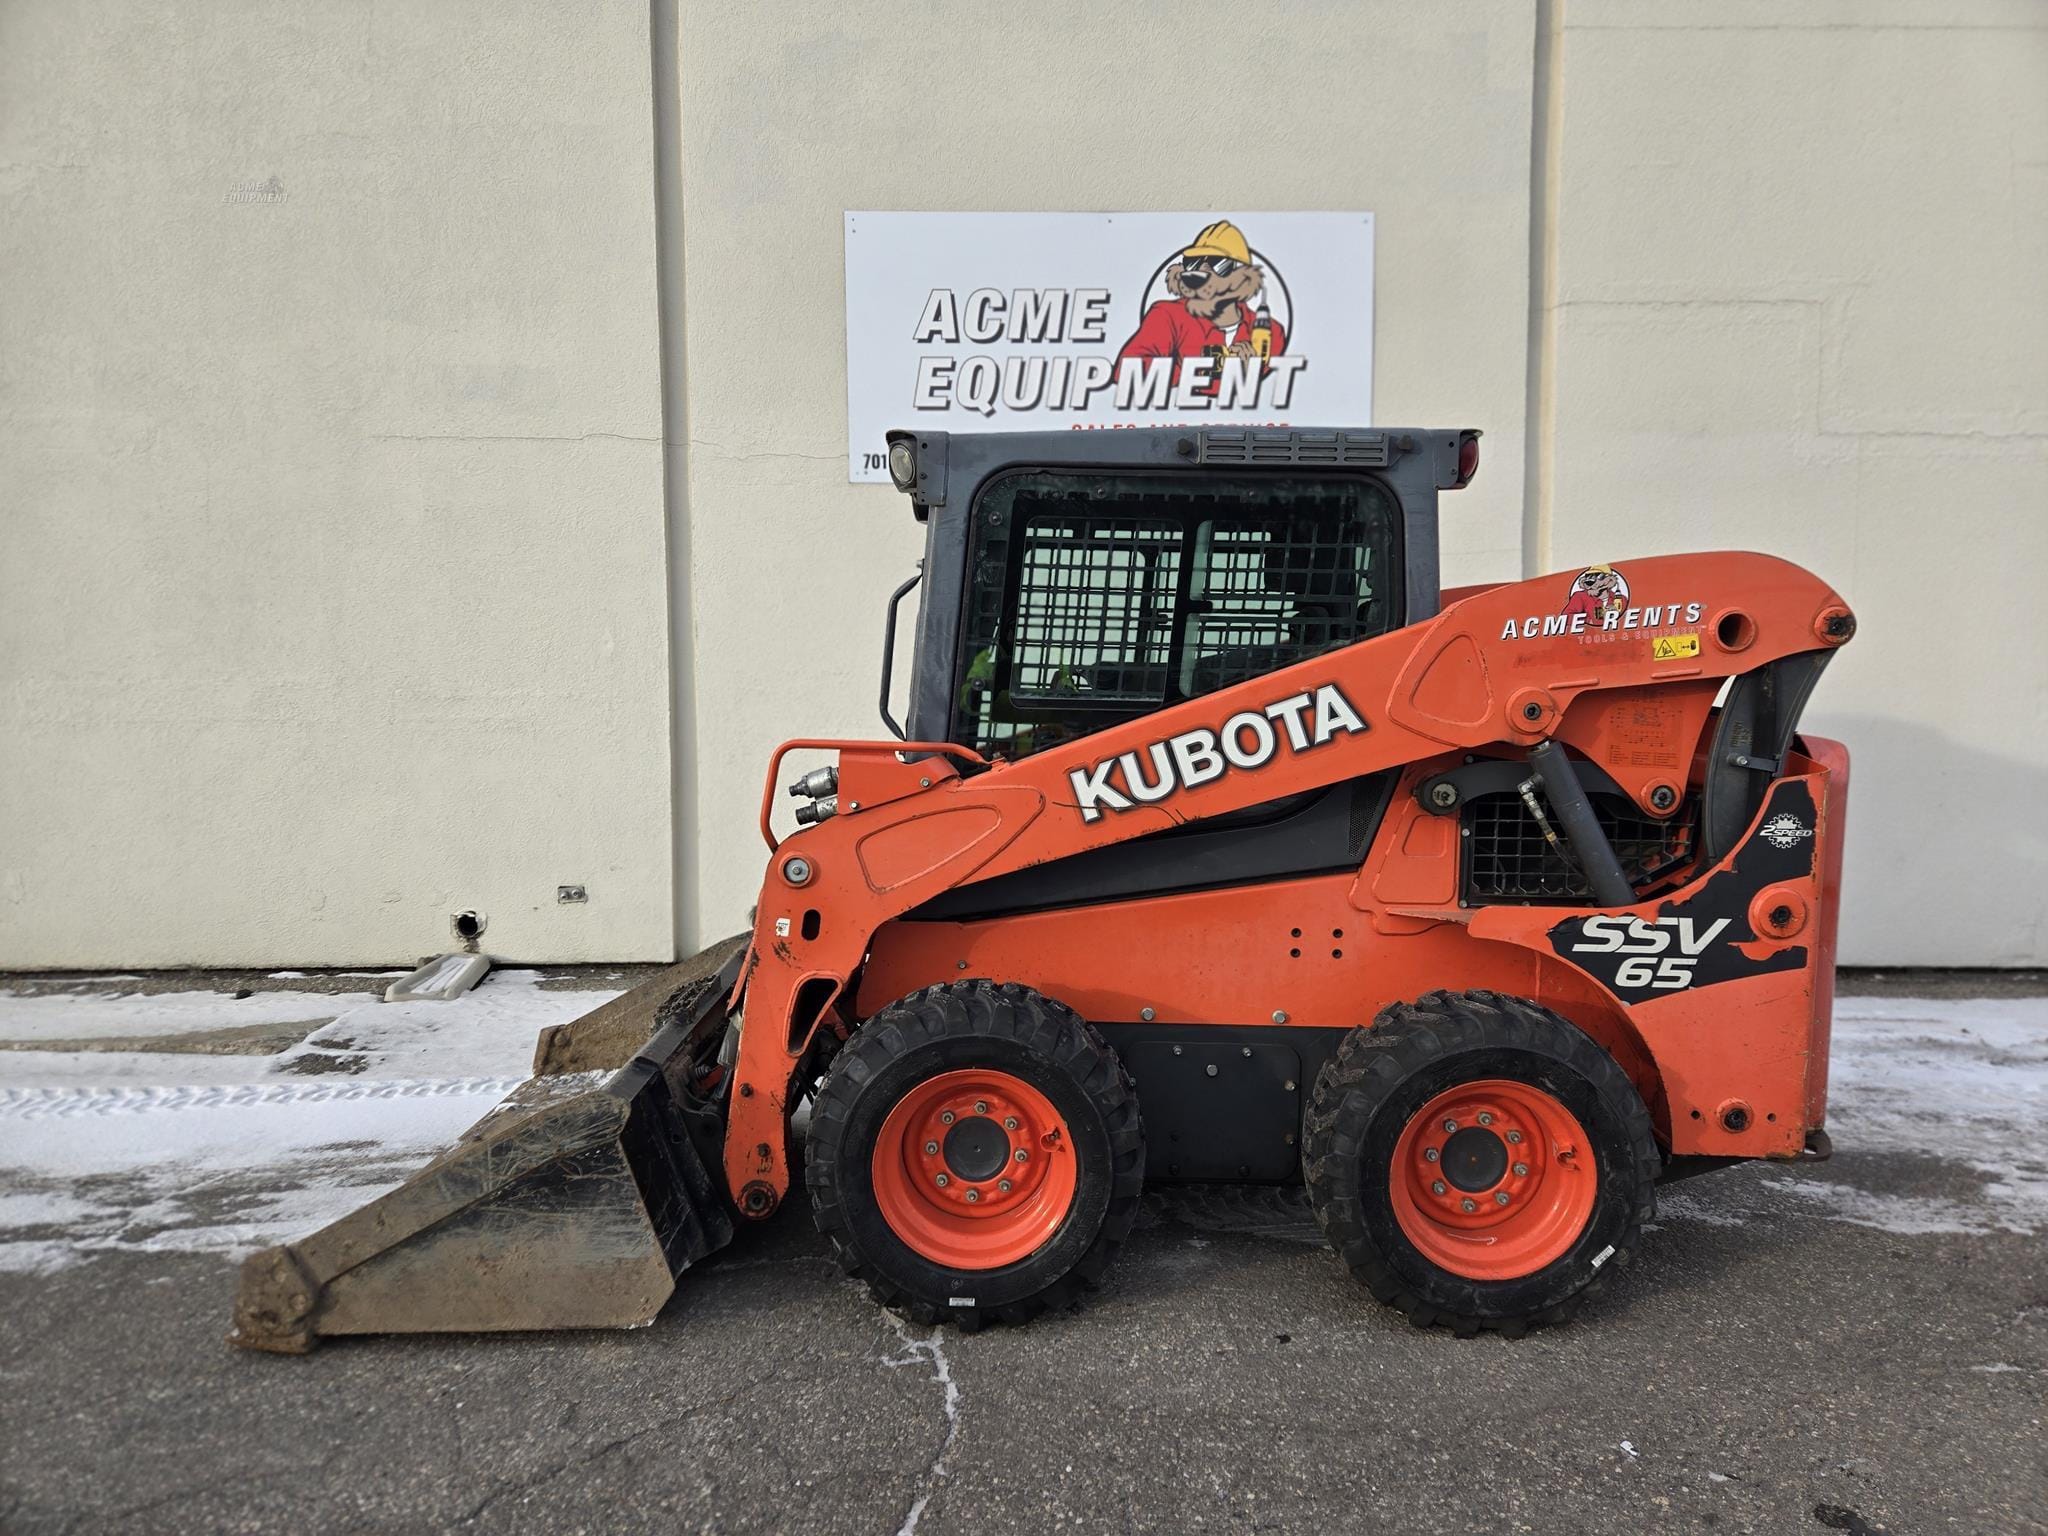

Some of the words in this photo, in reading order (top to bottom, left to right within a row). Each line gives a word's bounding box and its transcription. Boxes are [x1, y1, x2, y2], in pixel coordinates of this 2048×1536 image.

[913, 288, 1110, 343] ACME
[913, 356, 1307, 417] EQUIPMENT
[863, 453, 887, 470] 701
[1501, 612, 1588, 640] ACME
[1603, 603, 1702, 632] RENTS
[1068, 683, 1369, 825] KUBOTA
[1572, 915, 1732, 955] SSV
[1615, 957, 1697, 988] 65
